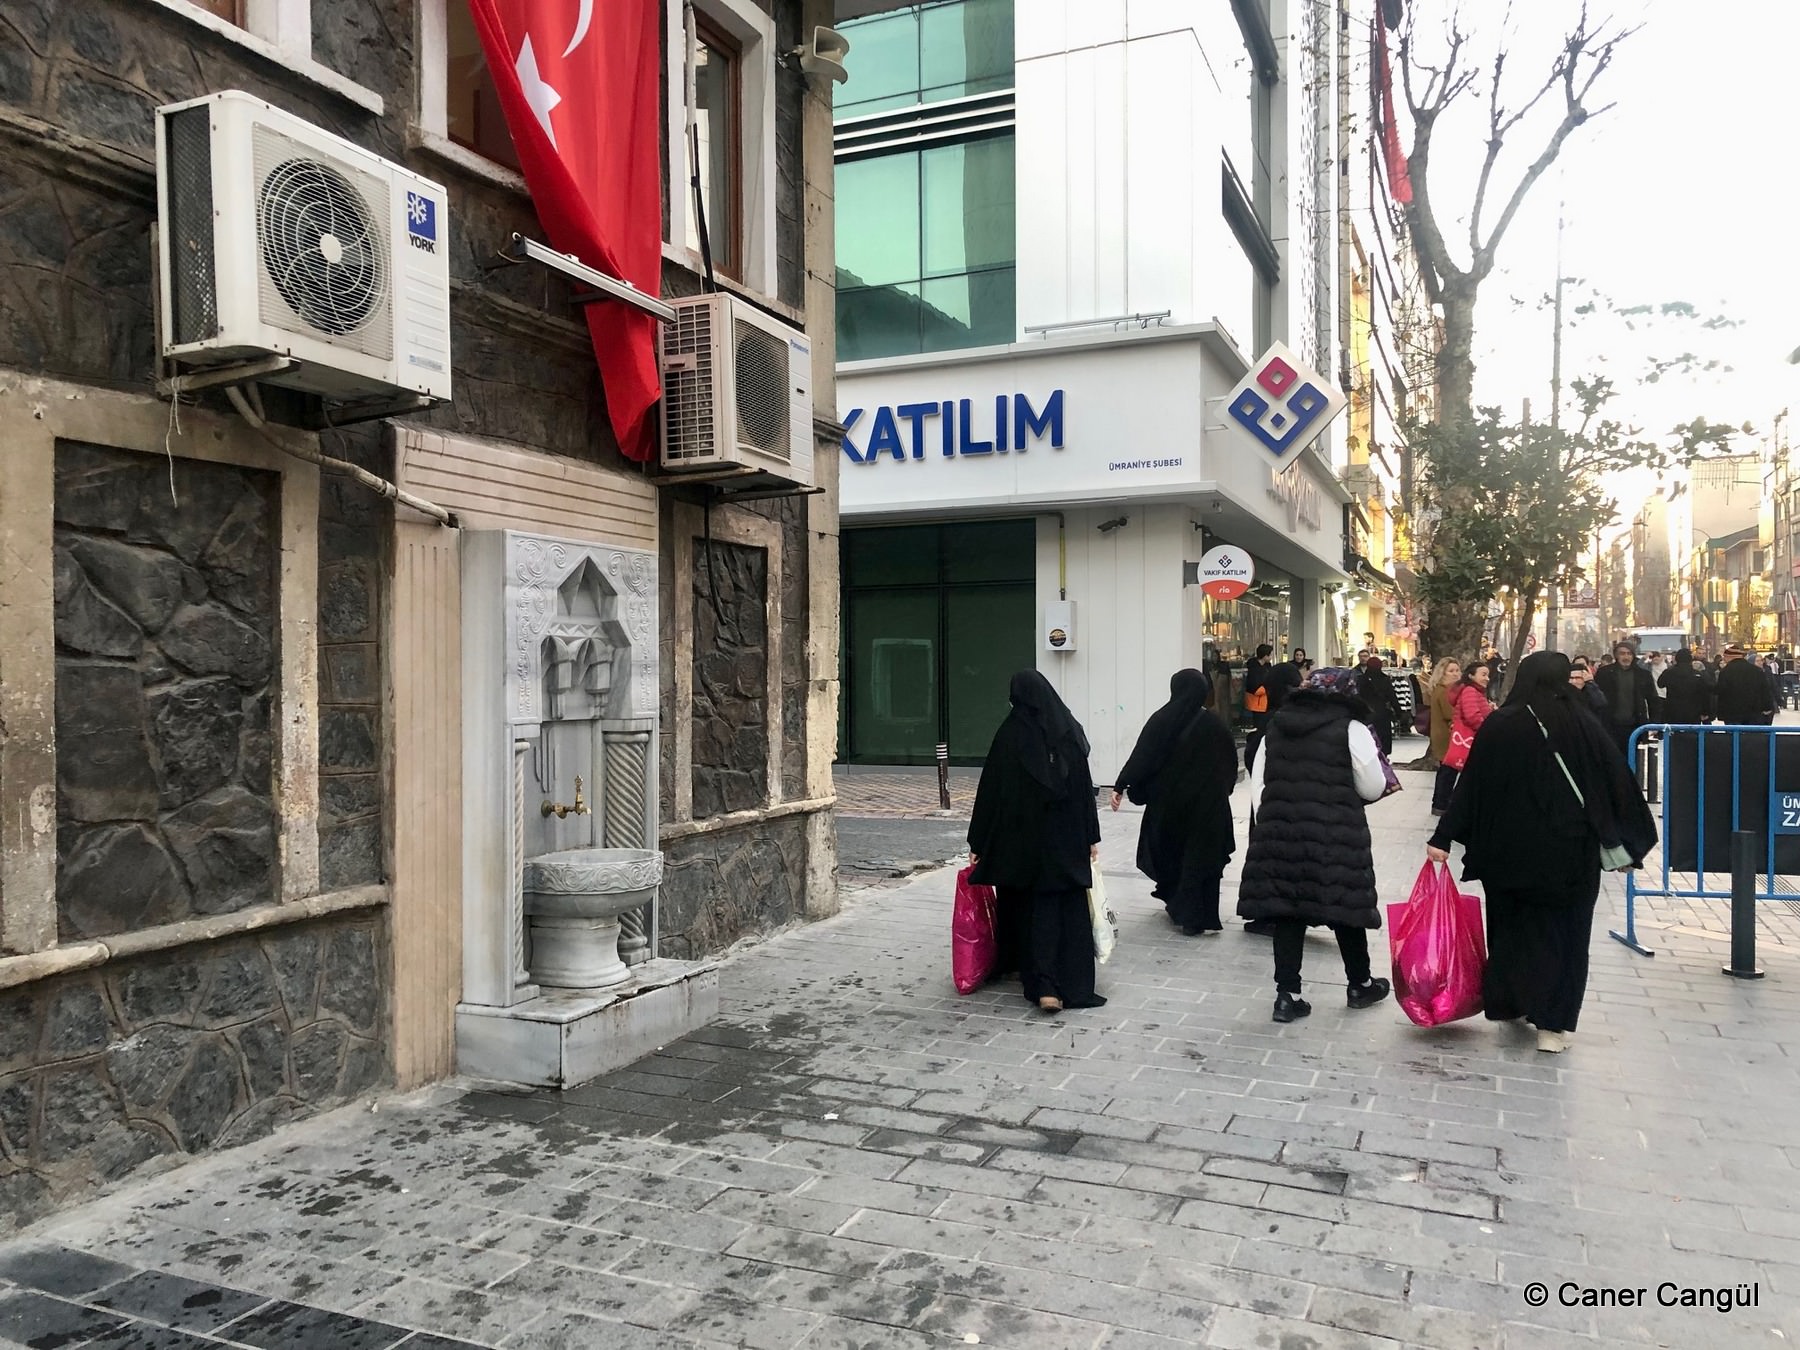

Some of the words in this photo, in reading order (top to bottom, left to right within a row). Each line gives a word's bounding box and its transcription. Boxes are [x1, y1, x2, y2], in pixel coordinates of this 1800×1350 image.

[409, 233, 435, 254] YORK
[841, 389, 1064, 463] KATILIM
[1109, 459, 1151, 471] ÜMRANİYE
[1153, 458, 1182, 468] ŞUBESİ
